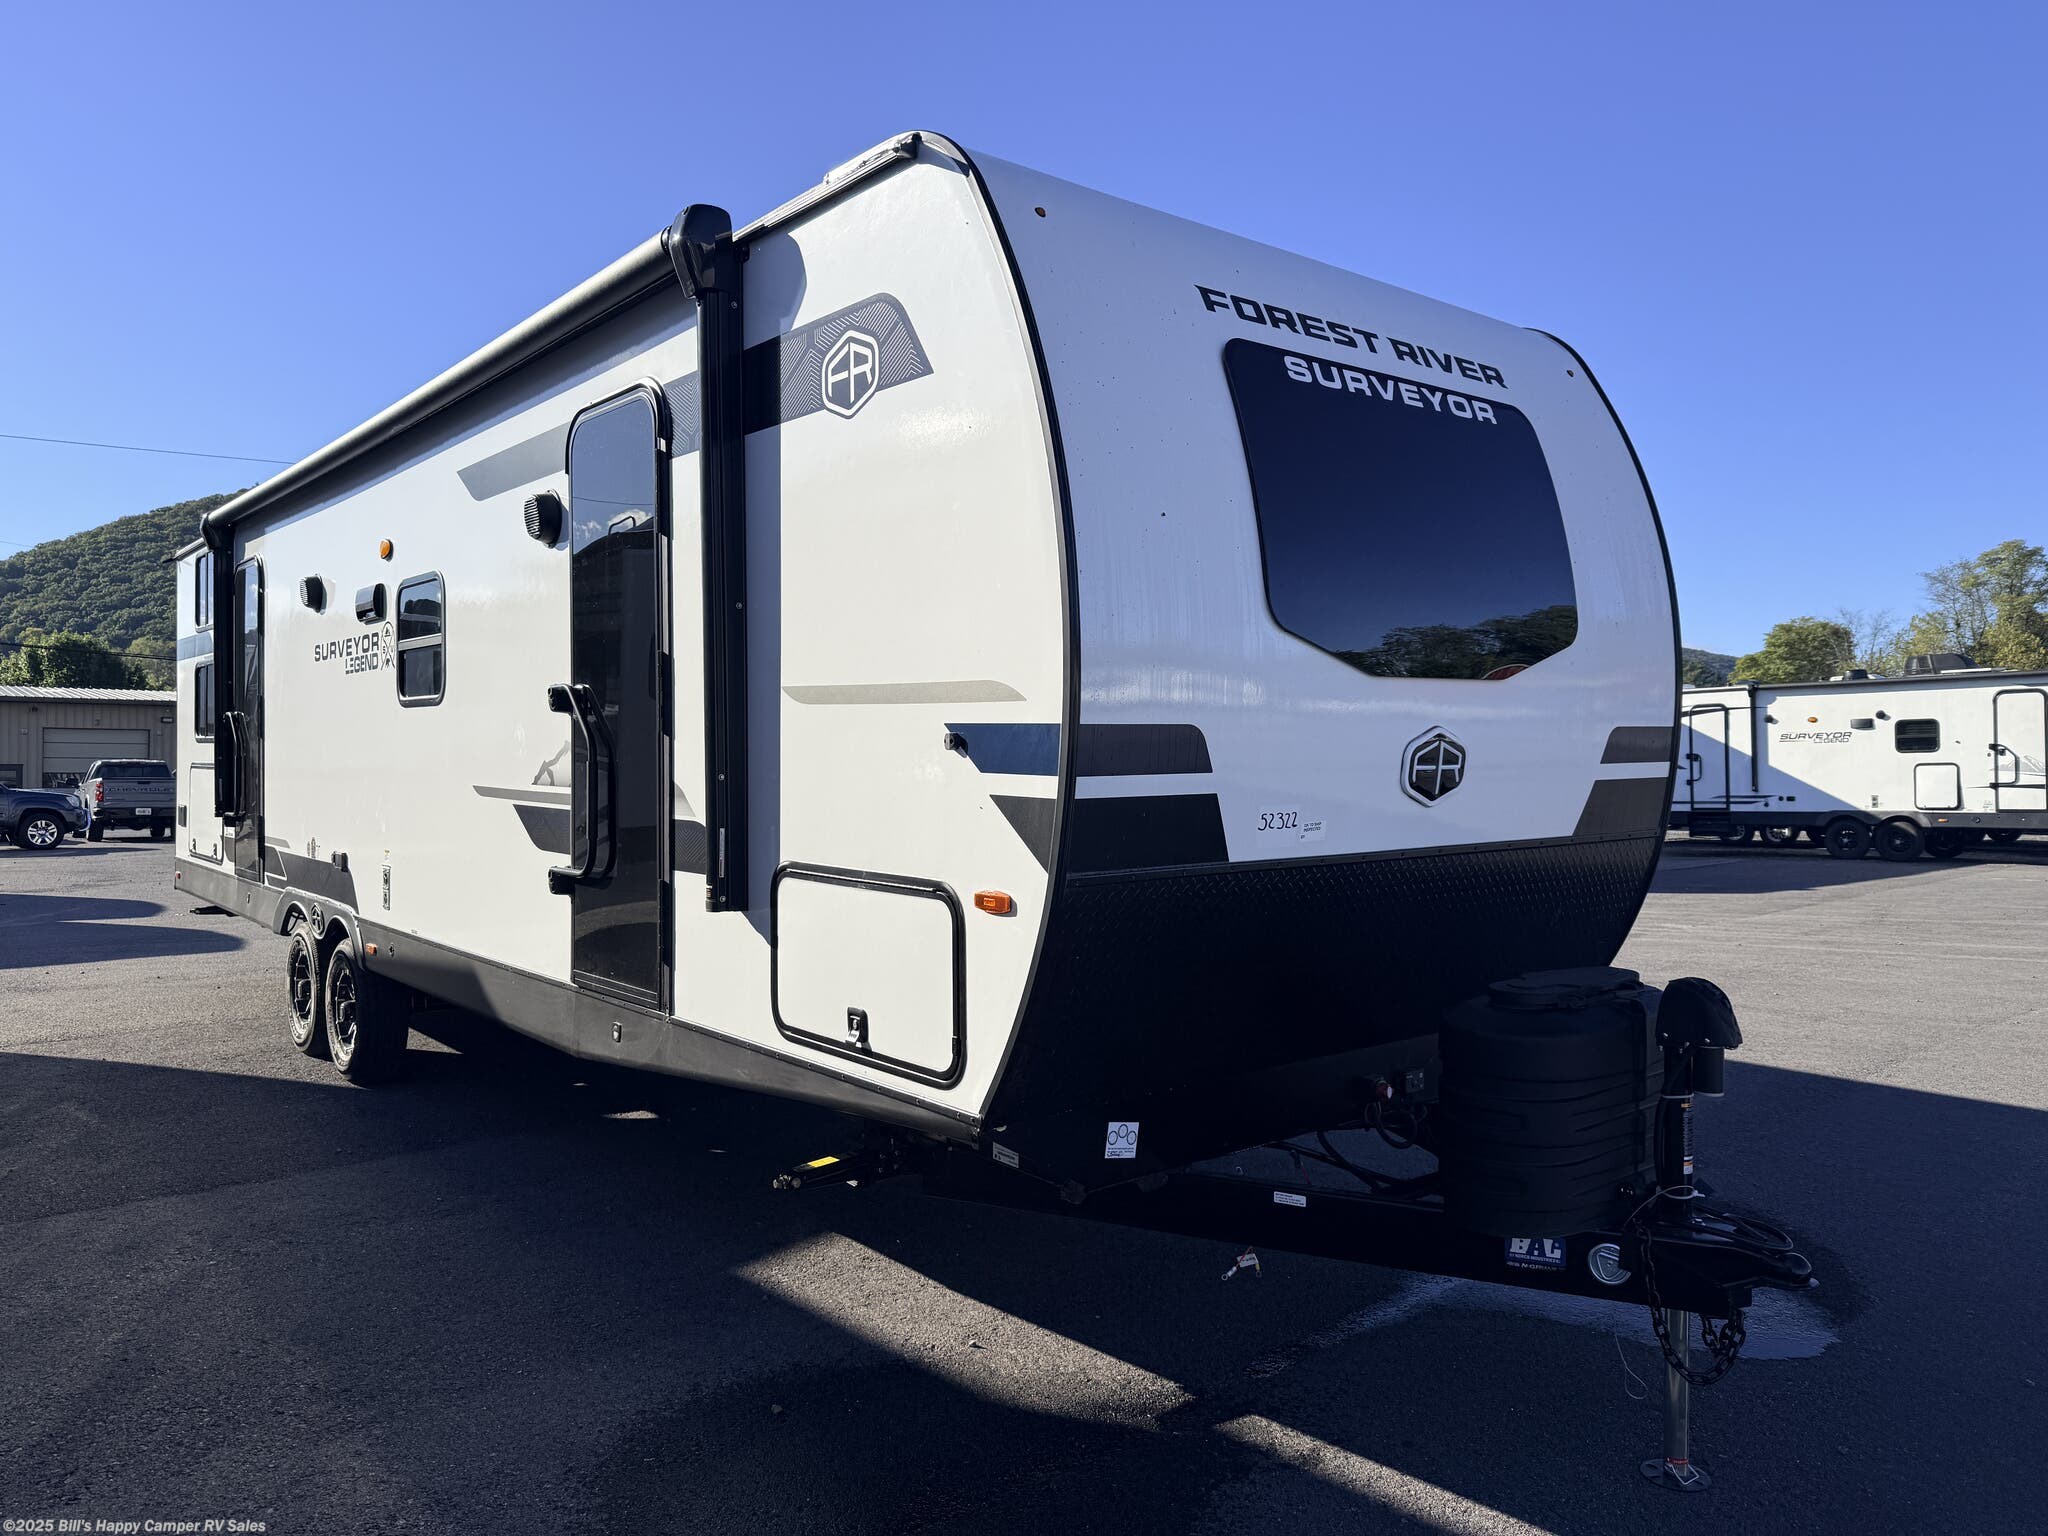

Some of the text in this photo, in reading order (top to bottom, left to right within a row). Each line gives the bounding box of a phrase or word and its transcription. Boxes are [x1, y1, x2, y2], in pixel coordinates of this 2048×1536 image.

[1194, 285, 1509, 389] FOREST RIVER
[1283, 355, 1497, 425] SURVEYOR
[314, 632, 379, 662] SURVEYOR
[345, 652, 379, 675] LEGEND
[1780, 731, 1853, 740] SURVEYOR
[1258, 811, 1298, 831] 52322
